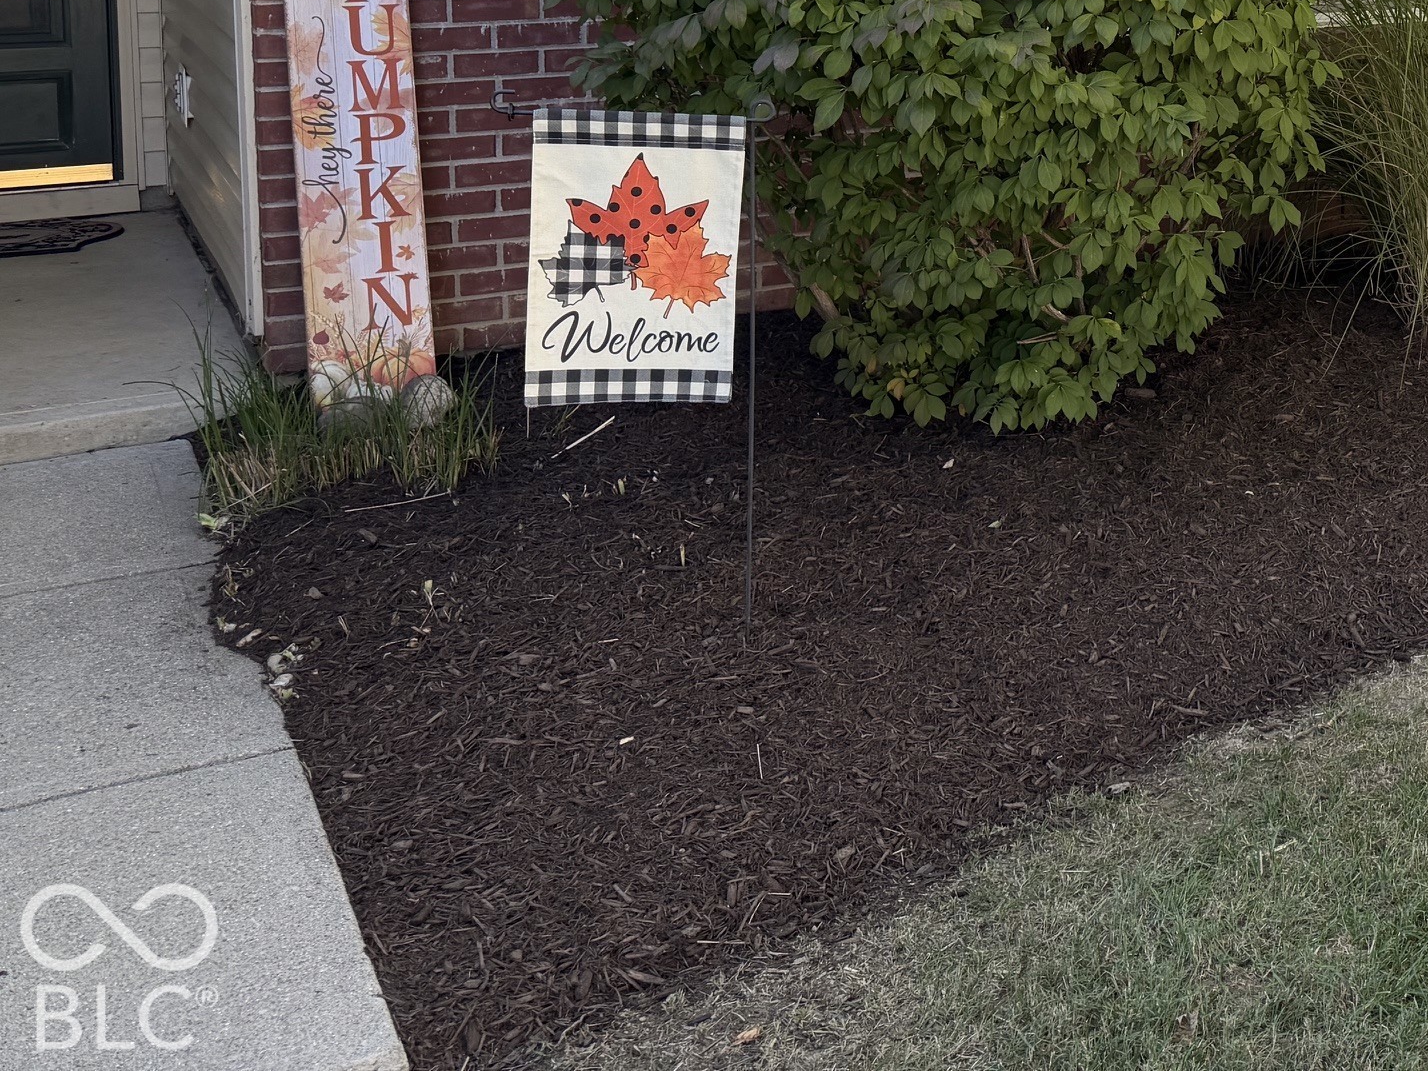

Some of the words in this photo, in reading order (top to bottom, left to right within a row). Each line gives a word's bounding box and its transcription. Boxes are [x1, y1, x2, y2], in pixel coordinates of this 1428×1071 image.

[301, 15, 337, 140] there
[302, 141, 352, 244] hey
[541, 311, 720, 362] Welcome
